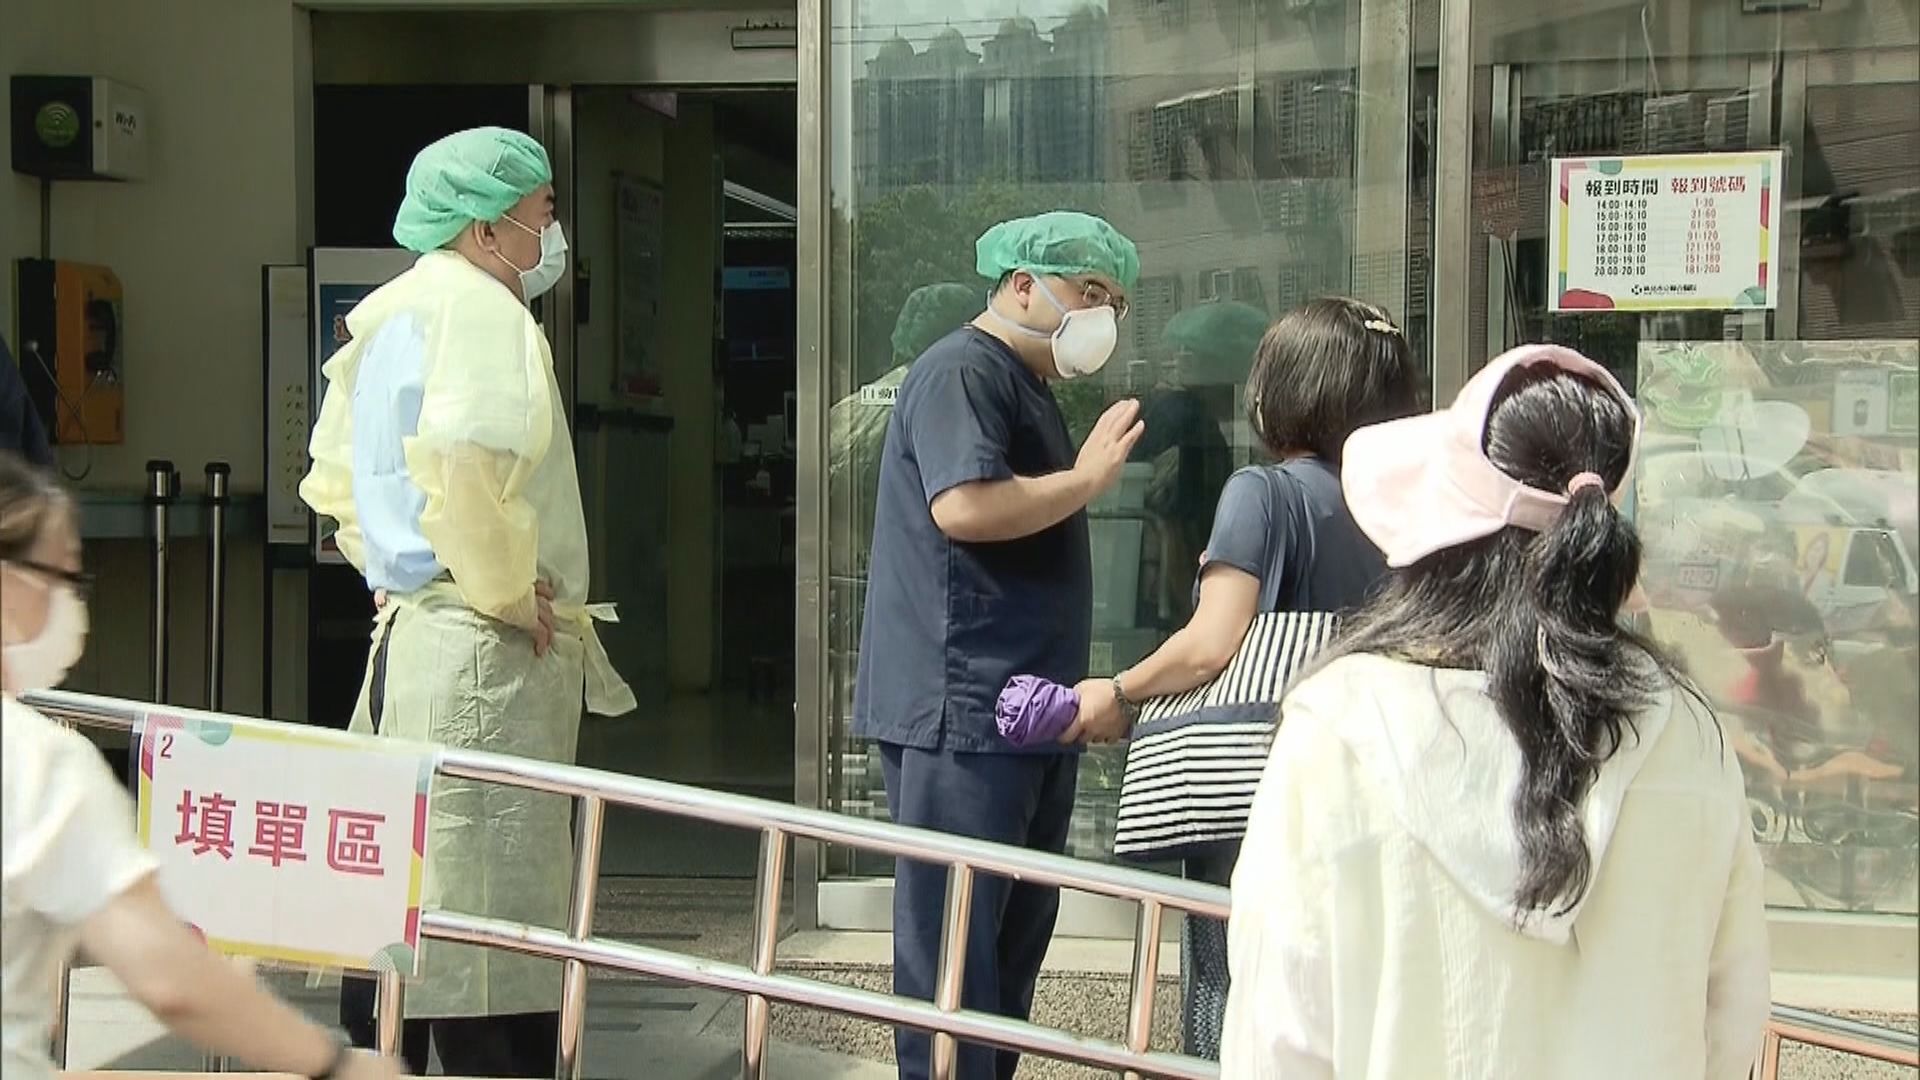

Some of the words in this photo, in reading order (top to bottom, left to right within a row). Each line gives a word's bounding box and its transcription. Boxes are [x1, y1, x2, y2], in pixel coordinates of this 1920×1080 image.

[1585, 178, 1659, 197] 報到時間
[1671, 176, 1746, 194] 報到號碼
[160, 734, 174, 759] 2
[175, 790, 386, 878] 填單區
